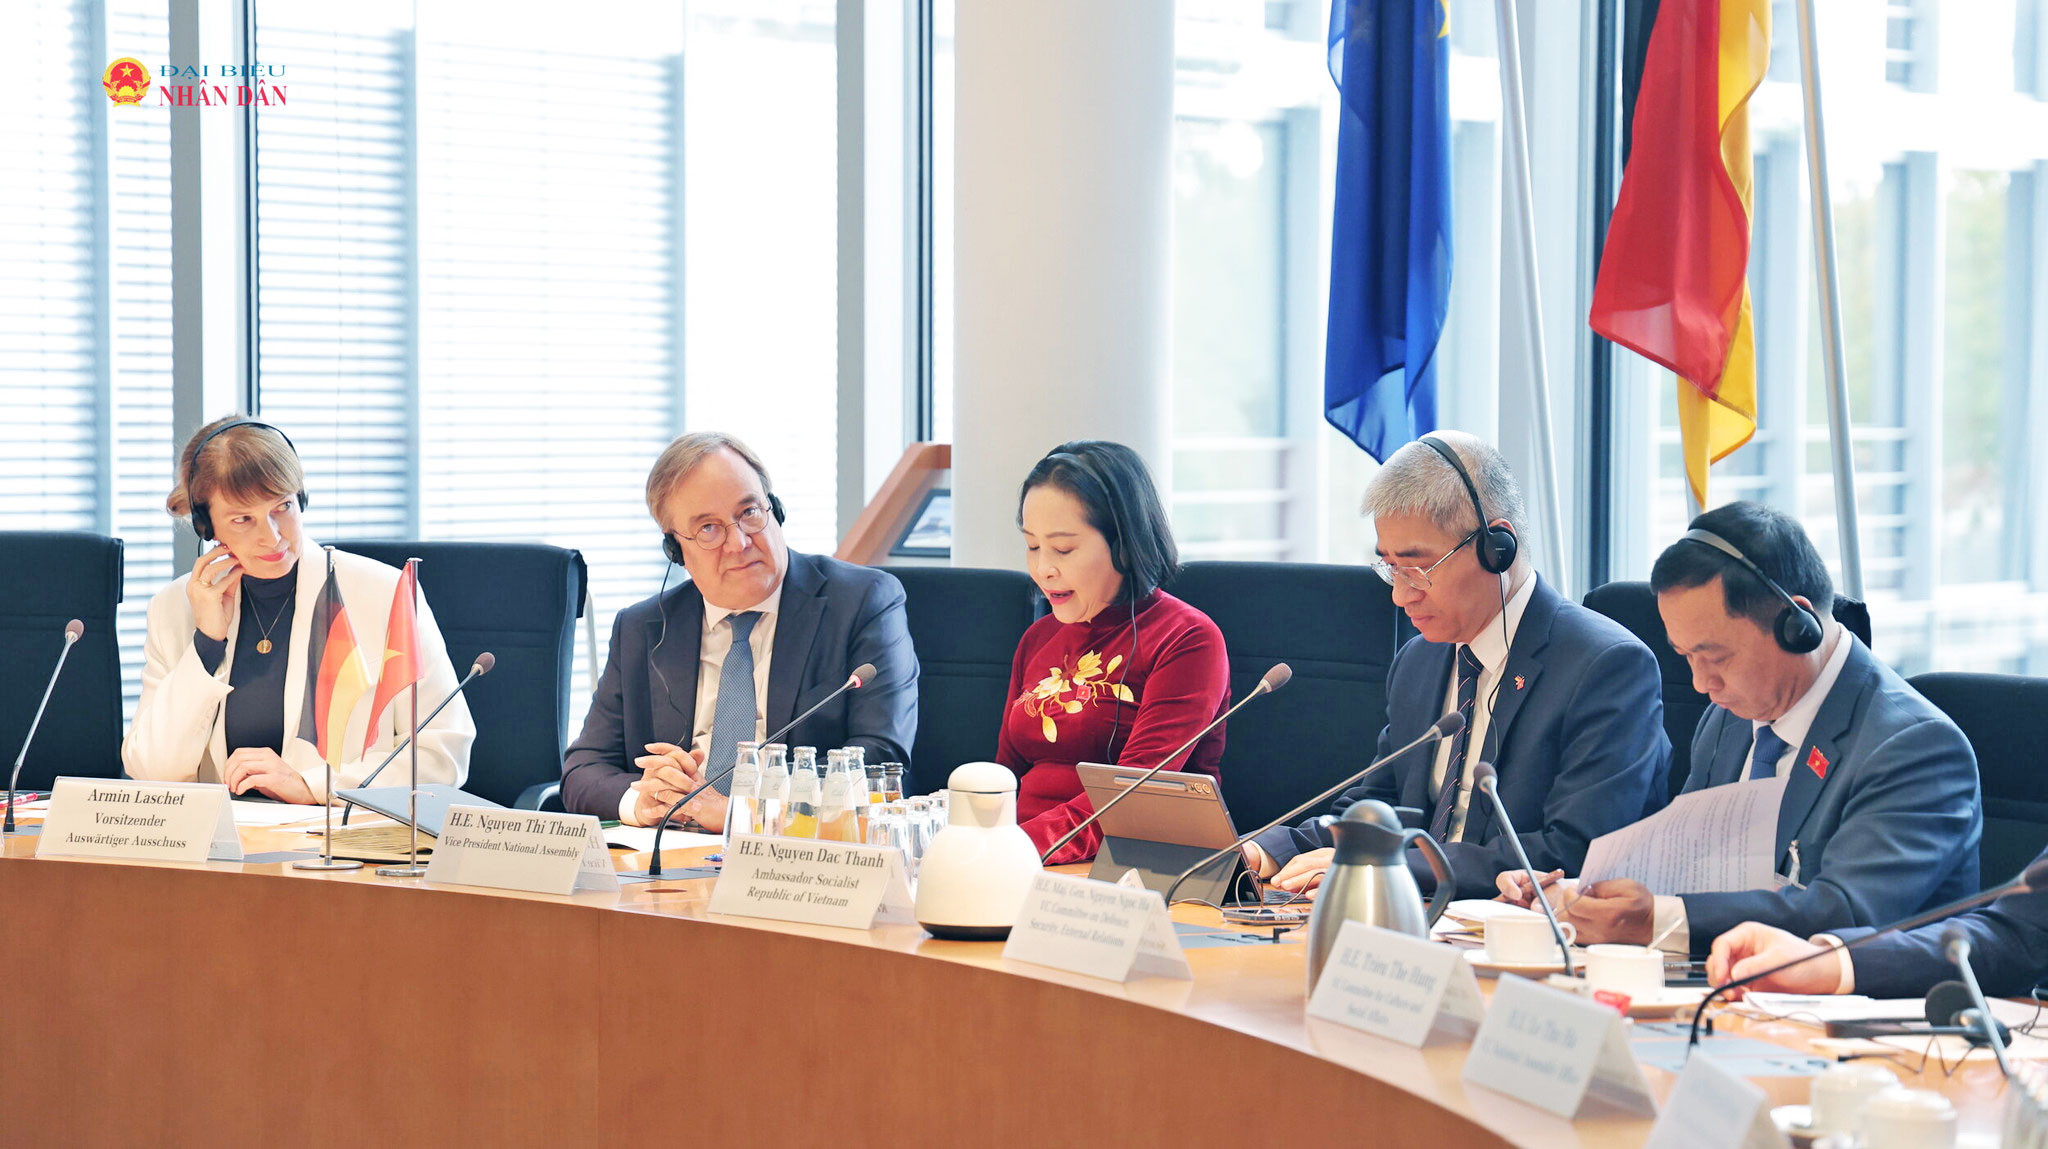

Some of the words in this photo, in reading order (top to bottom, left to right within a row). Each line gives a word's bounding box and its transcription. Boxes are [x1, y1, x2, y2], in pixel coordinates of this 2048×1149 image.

[87, 788, 130, 803] Armin
[134, 790, 185, 806] Laschet
[94, 812, 166, 828] Vorsitzender
[450, 812, 474, 828] H.E.
[476, 815, 521, 834] Nguyen
[525, 818, 546, 834] Thi
[549, 820, 587, 838] Thanh
[66, 831, 130, 848] Auswärtiger
[131, 834, 187, 849] Ausschuss
[444, 835, 462, 848] Vice
[462, 836, 501, 851] President
[504, 841, 538, 855] National
[539, 844, 580, 860] Assembly
[738, 840, 764, 857] H.E.
[767, 843, 813, 864] Nguyen
[816, 848, 840, 864] Dac
[844, 850, 884, 868] Thanh
[751, 867, 814, 885] Ambassador
[815, 873, 860, 889] Socialist
[747, 886, 792, 903] Republic
[793, 890, 805, 903] of
[805, 893, 849, 908] Vietnam
